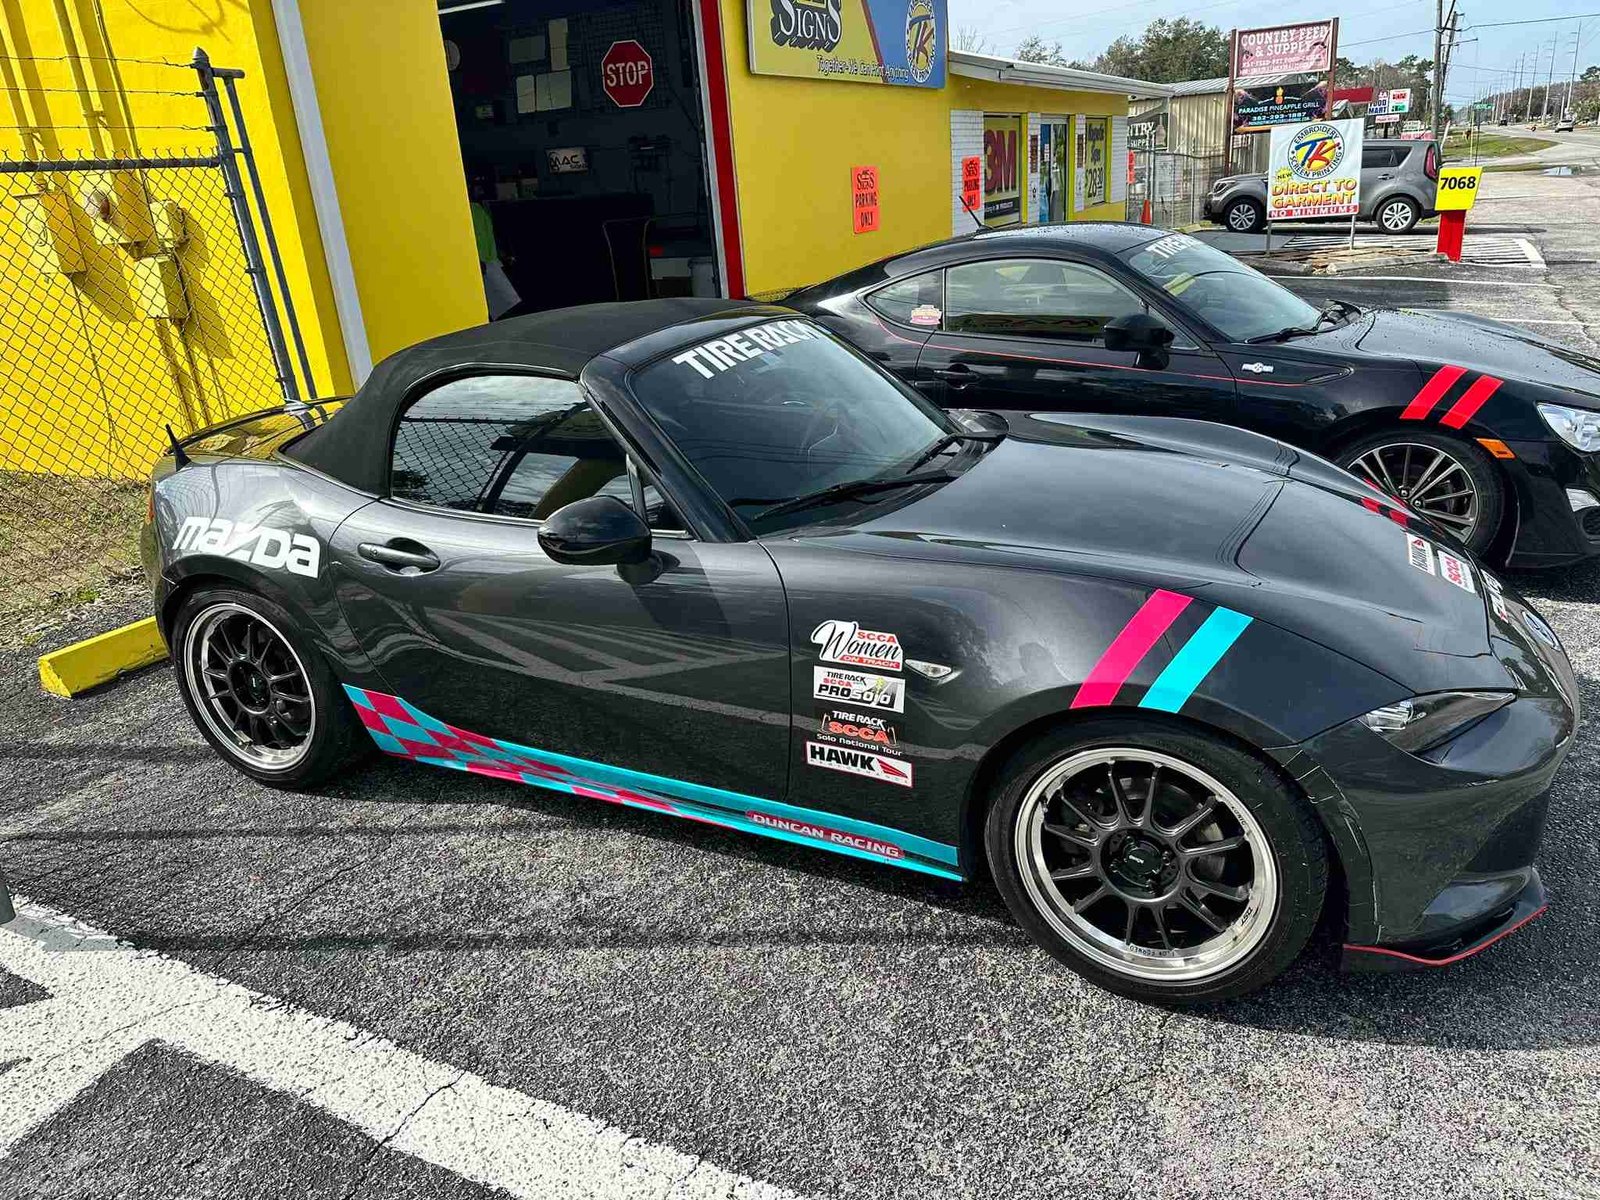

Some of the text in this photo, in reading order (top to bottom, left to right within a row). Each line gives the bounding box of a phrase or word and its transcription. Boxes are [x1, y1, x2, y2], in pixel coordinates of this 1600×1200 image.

[1241, 25, 1329, 47] COUNTRY FEED
[1255, 42, 1311, 57] & SUPPLY
[606, 61, 650, 87] STOP
[1238, 106, 1268, 114] PARADISE
[1269, 103, 1302, 111] PINEAPPLE
[1294, 126, 1340, 145] EMBROIDERY
[1294, 136, 1341, 169] TK
[984, 129, 1018, 195] 3M
[1289, 152, 1343, 178] SCREEN PRINTING
[1277, 172, 1293, 180] NEW
[1440, 176, 1476, 190] 7068
[1272, 178, 1357, 196] DIRECT TO
[855, 191, 878, 209] PARKING
[1271, 191, 1356, 209] GARMENT
[860, 210, 873, 227] ONLY
[1270, 205, 1356, 218] NO MINIMUMS
[671, 318, 821, 379] TIRE RACK
[812, 621, 901, 660] Women
[857, 631, 897, 644] SCCA
[861, 656, 900, 668] TRACK
[823, 677, 853, 688] SCCA
[826, 670, 867, 686] TIRE RACK
[832, 710, 887, 731] TIRE RACK
[828, 721, 890, 744] SCCA
[817, 733, 837, 742] Solo
[882, 746, 902, 757] Tour
[810, 745, 876, 772] HAWK
[753, 814, 899, 857] DUNCAN RACING
